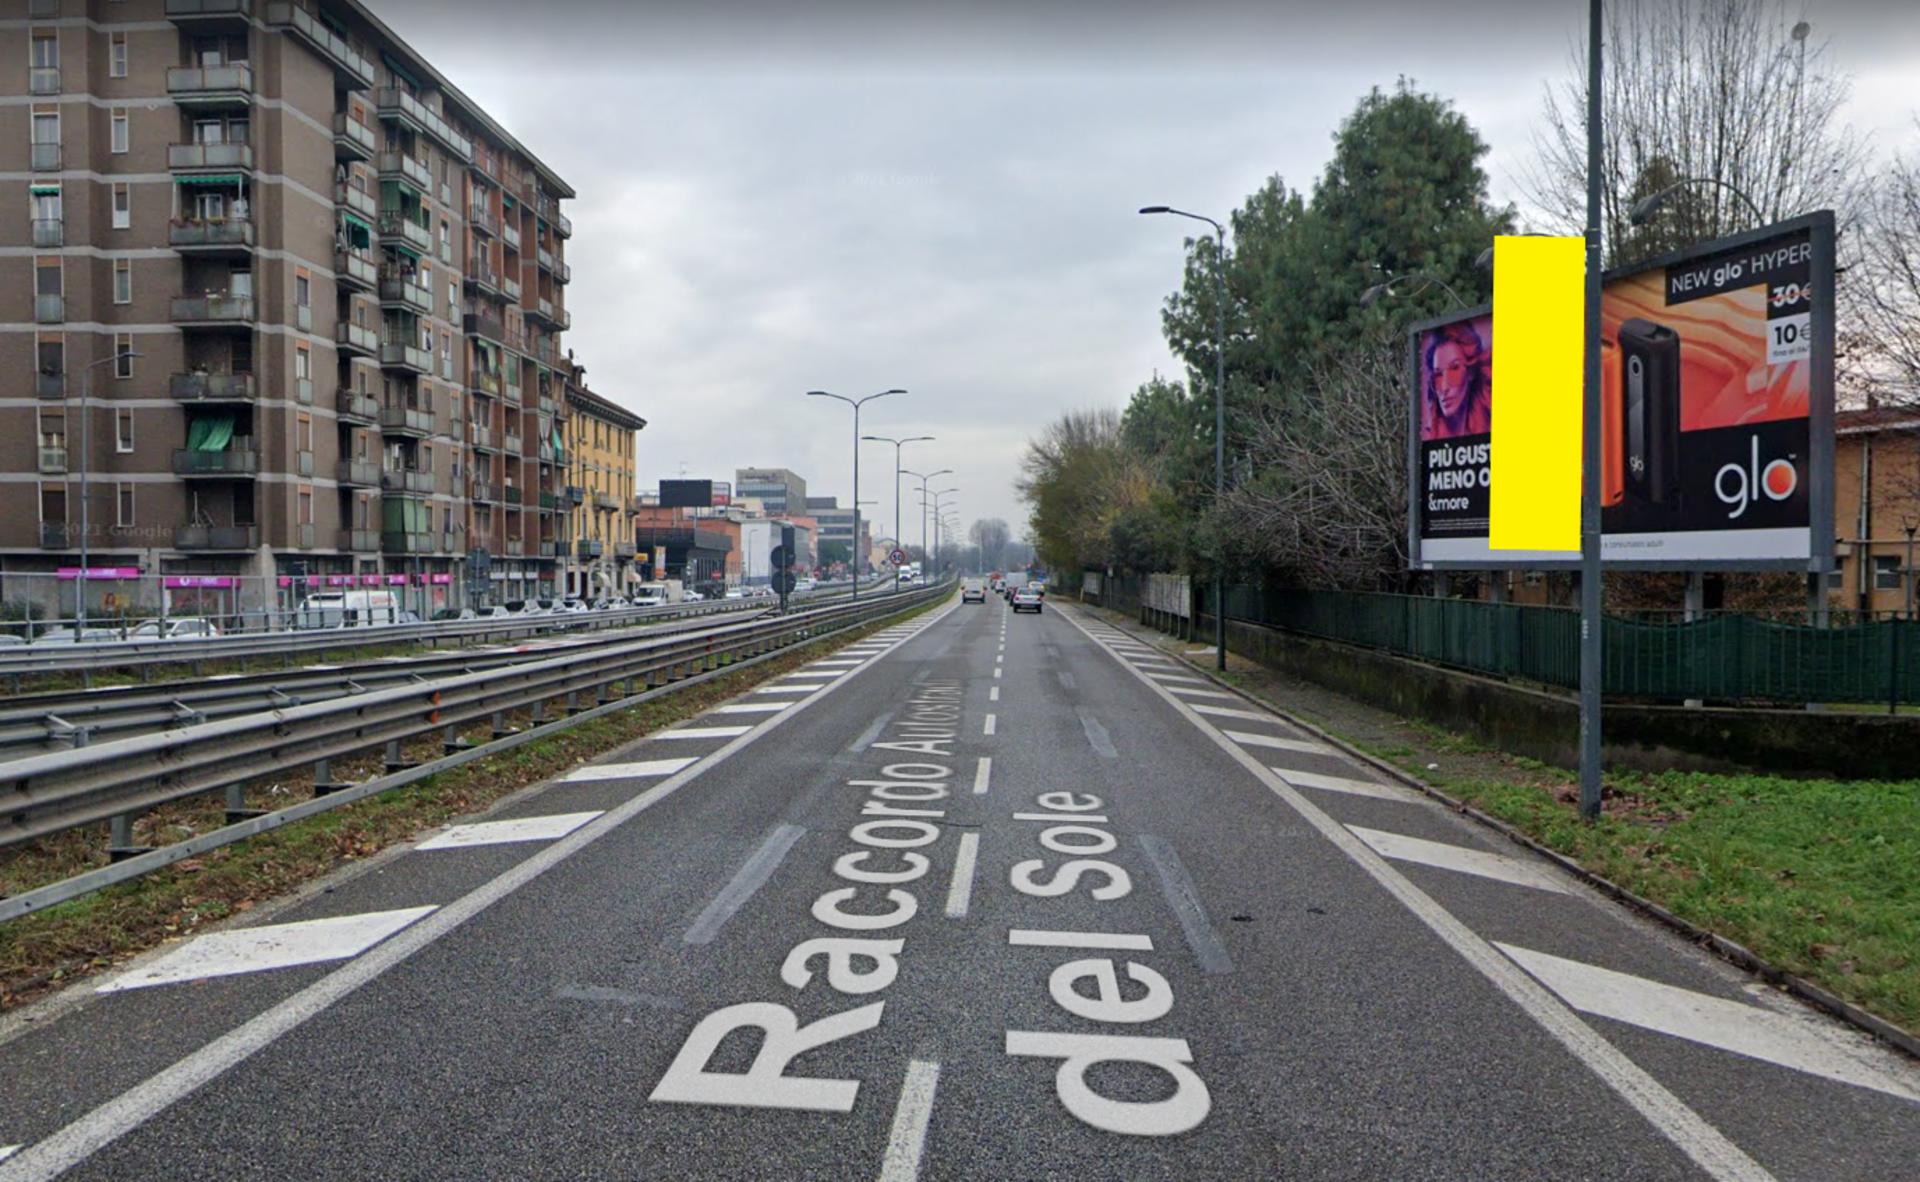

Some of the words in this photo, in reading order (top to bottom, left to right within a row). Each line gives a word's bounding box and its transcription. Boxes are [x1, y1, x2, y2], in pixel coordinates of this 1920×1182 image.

[1672, 268, 1710, 294] NEW
[1752, 242, 1812, 274] HYPER
[1429, 443, 1453, 468] PIÙ
[1429, 469, 1476, 491] MENO
[1428, 493, 1470, 511] &more
[1010, 791, 1132, 900] Sole
[648, 763, 953, 1112] Raccordo
[1006, 929, 1211, 1136] del
